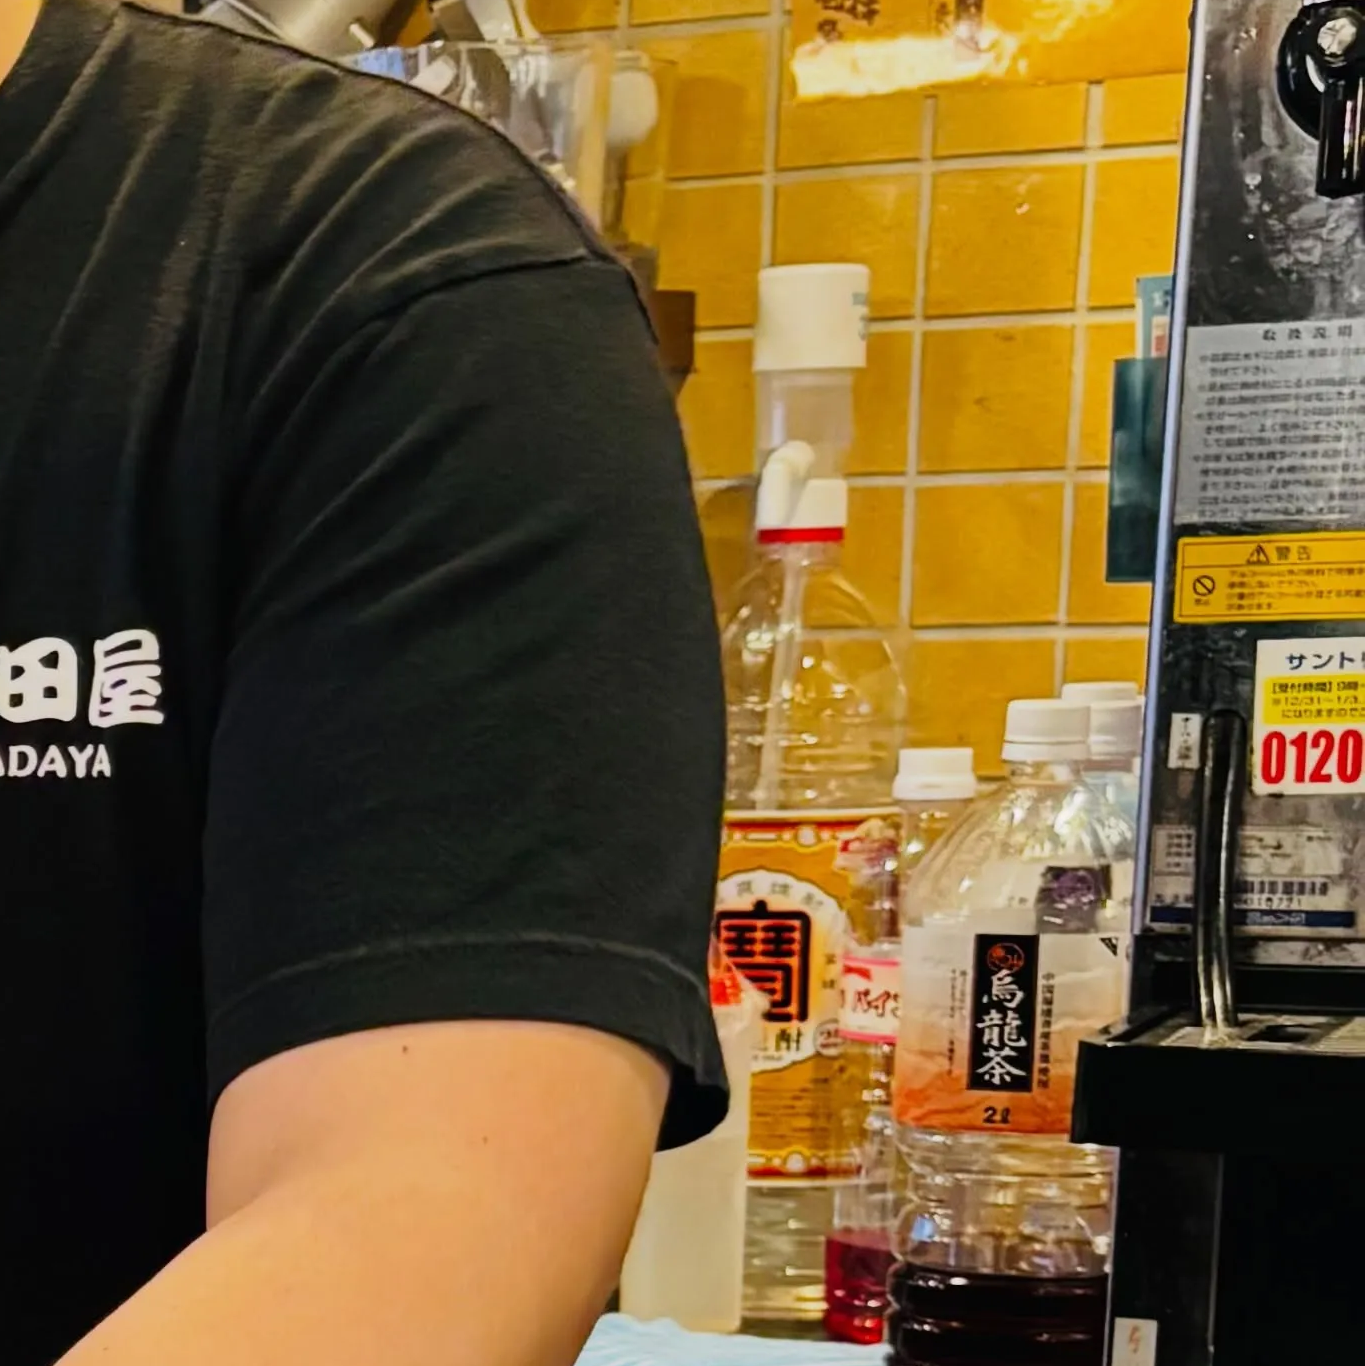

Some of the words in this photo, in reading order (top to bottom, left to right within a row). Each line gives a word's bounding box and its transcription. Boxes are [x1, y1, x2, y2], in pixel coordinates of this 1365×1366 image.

[1287, 651, 1365, 670] サント
[1261, 729, 1363, 784] 0120
[975, 969, 1027, 1085] 烏龍茶
